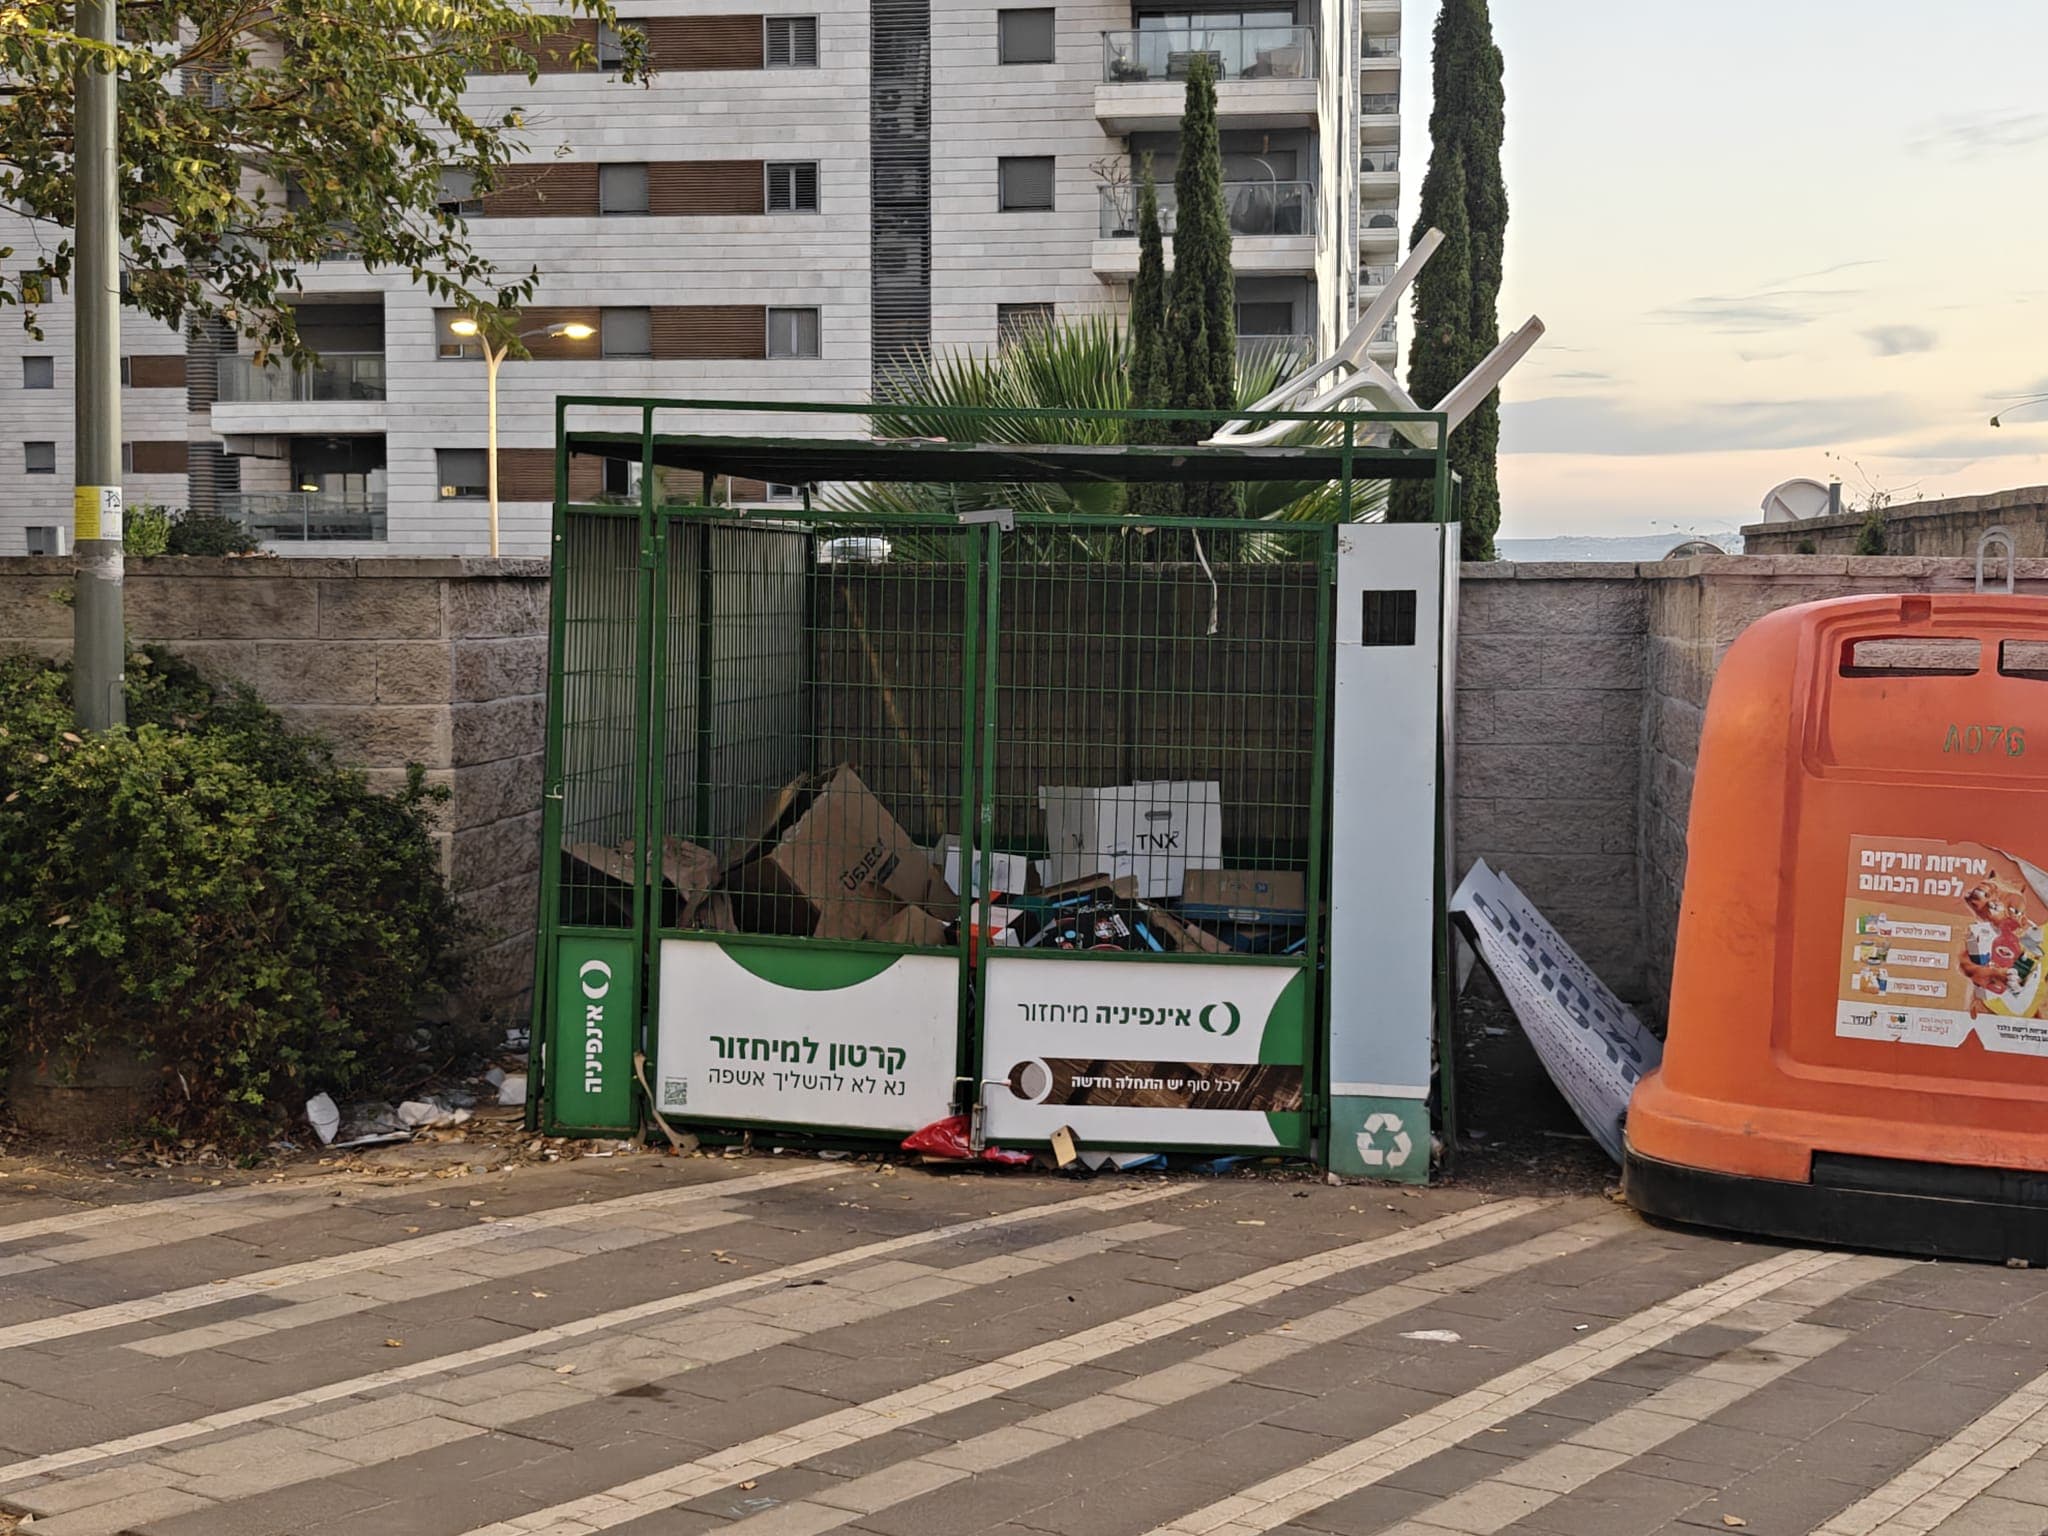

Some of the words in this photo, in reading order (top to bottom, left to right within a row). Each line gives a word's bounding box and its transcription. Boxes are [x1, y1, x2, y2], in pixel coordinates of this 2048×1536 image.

[1943, 724, 2025, 756] A076
[1136, 832, 1178, 850] TNX
[1861, 850, 1922, 873] זורקים
[1925, 854, 1988, 876] אריזות
[1859, 874, 1919, 894] הכתום
[1923, 876, 1964, 897] לפח
[1017, 1003, 1089, 1023] מיחזור
[1096, 1005, 1192, 1026] אינפיניה
[585, 1004, 603, 1093] אינפיניה
[710, 1035, 819, 1064] למיחזור
[829, 1042, 907, 1075] קרטון
[709, 1068, 765, 1086] אשפה
[773, 1071, 844, 1092] להשליך
[852, 1076, 876, 1094] לא
[884, 1078, 906, 1096] נא
[1071, 1075, 1114, 1089] חדשה
[1115, 1076, 1163, 1091] התחלה
[1167, 1078, 1184, 1090] יש
[1187, 1079, 1210, 1094] סוף
[1215, 1077, 1241, 1094] לכל
